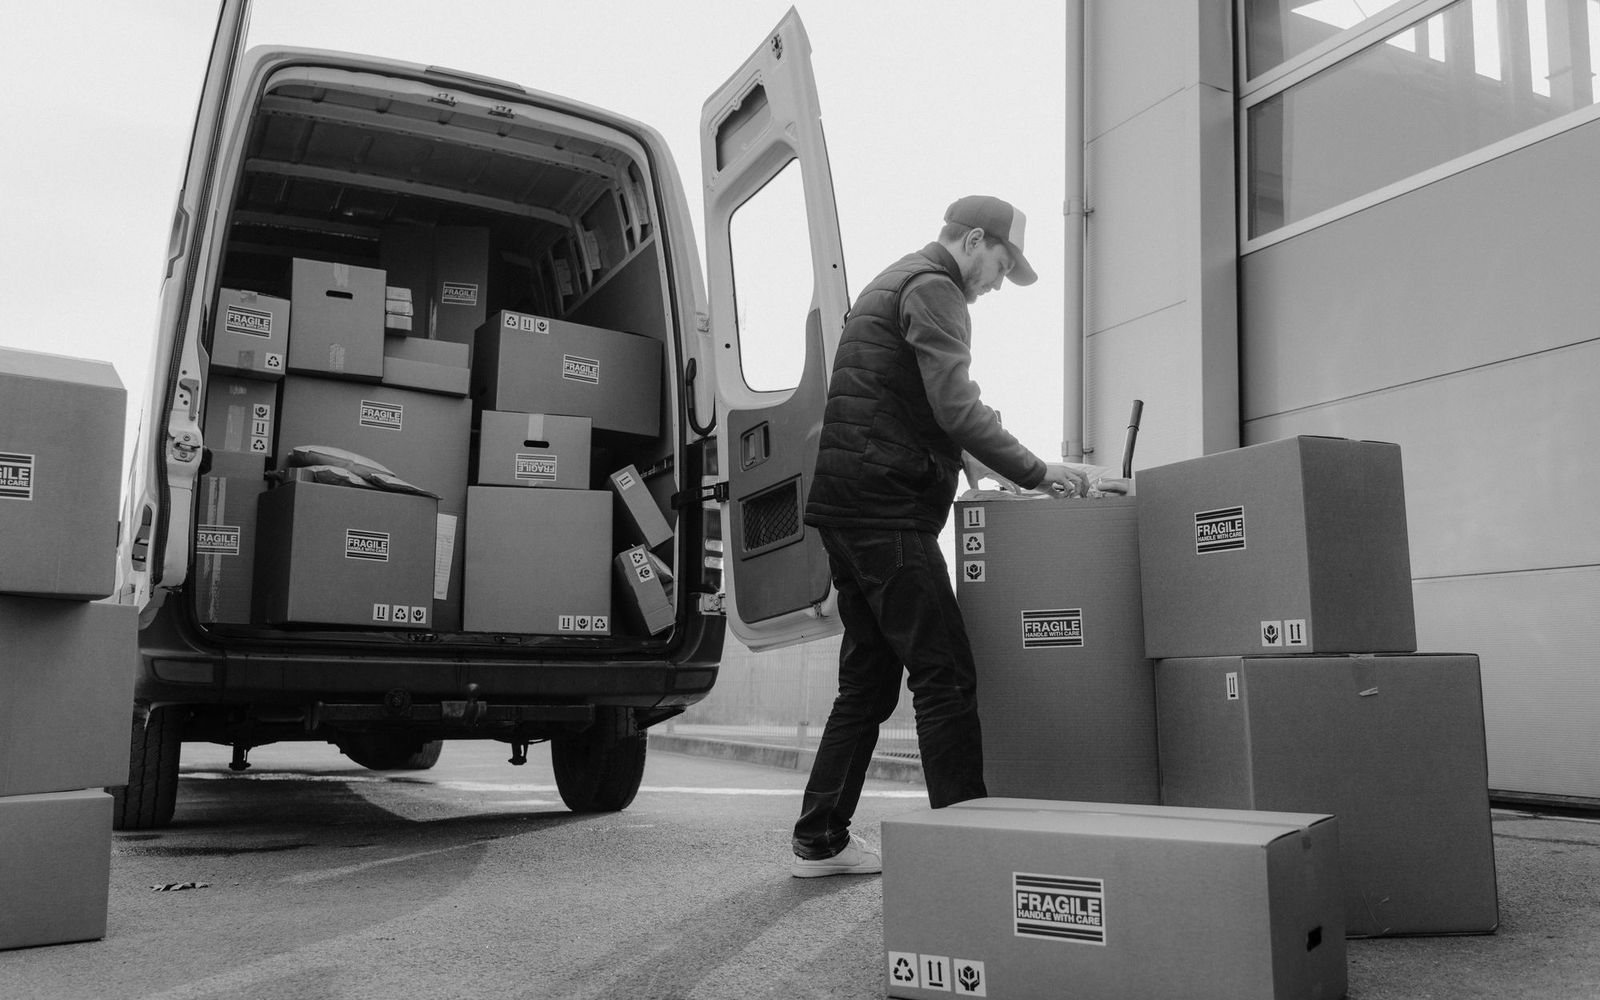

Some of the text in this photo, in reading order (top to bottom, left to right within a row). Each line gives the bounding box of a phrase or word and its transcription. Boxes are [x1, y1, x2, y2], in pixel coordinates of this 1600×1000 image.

[444, 288, 475, 298] FRAGILE
[228, 313, 270, 328] FRAGILE
[565, 362, 597, 374] FRAGILE
[362, 408, 400, 420] FRAGILE
[518, 464, 555, 473] FRAGILE
[7, 479, 29, 487] CARE
[1197, 519, 1243, 537] FRAGILE
[348, 538, 387, 550] FRAGILE
[1198, 534, 1217, 542] HANDLE
[1025, 621, 1080, 632] FRAGILE
[1018, 893, 1101, 917] FRAGILE
[1018, 910, 1101, 926] HANDLE WITH CARE
